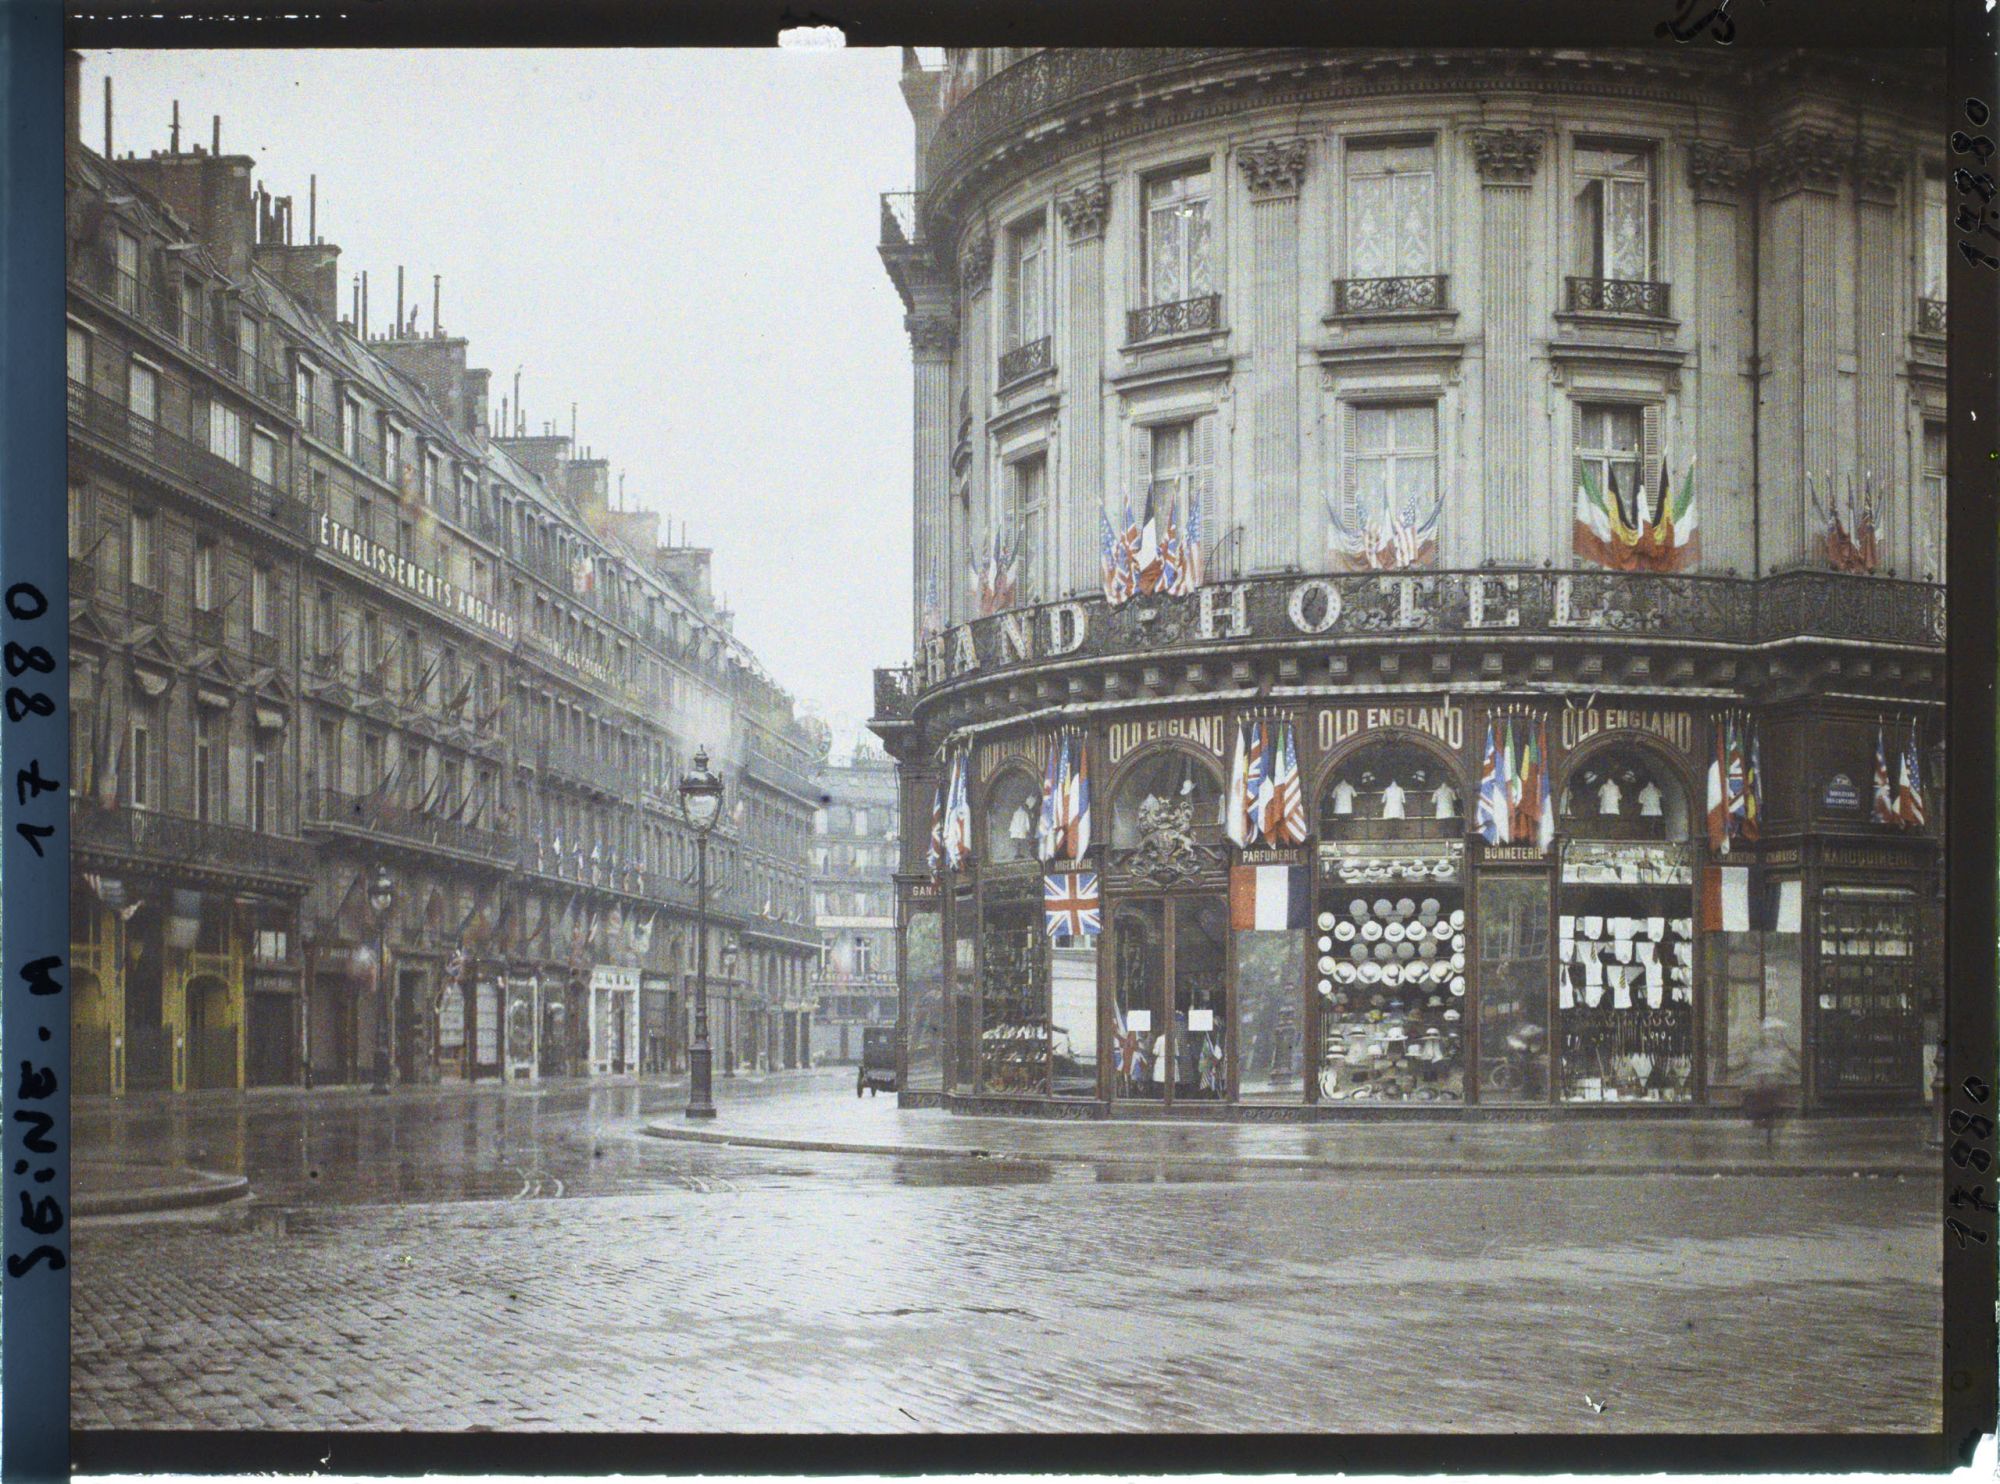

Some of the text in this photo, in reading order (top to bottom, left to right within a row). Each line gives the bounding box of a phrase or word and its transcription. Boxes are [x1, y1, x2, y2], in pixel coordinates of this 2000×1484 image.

[320, 511, 451, 608] ÉTABLISSEMENTS
[1193, 574, 1608, 641] HOTEL
[1109, 715, 1225, 763] OLD ENGLAND
[1318, 707, 1464, 751] OLD ENGLAND
[1561, 708, 1692, 753] OLD ENGLAND
[1242, 848, 1299, 863] PARFUMERIE
[1483, 847, 1544, 860] BONNETERIE
